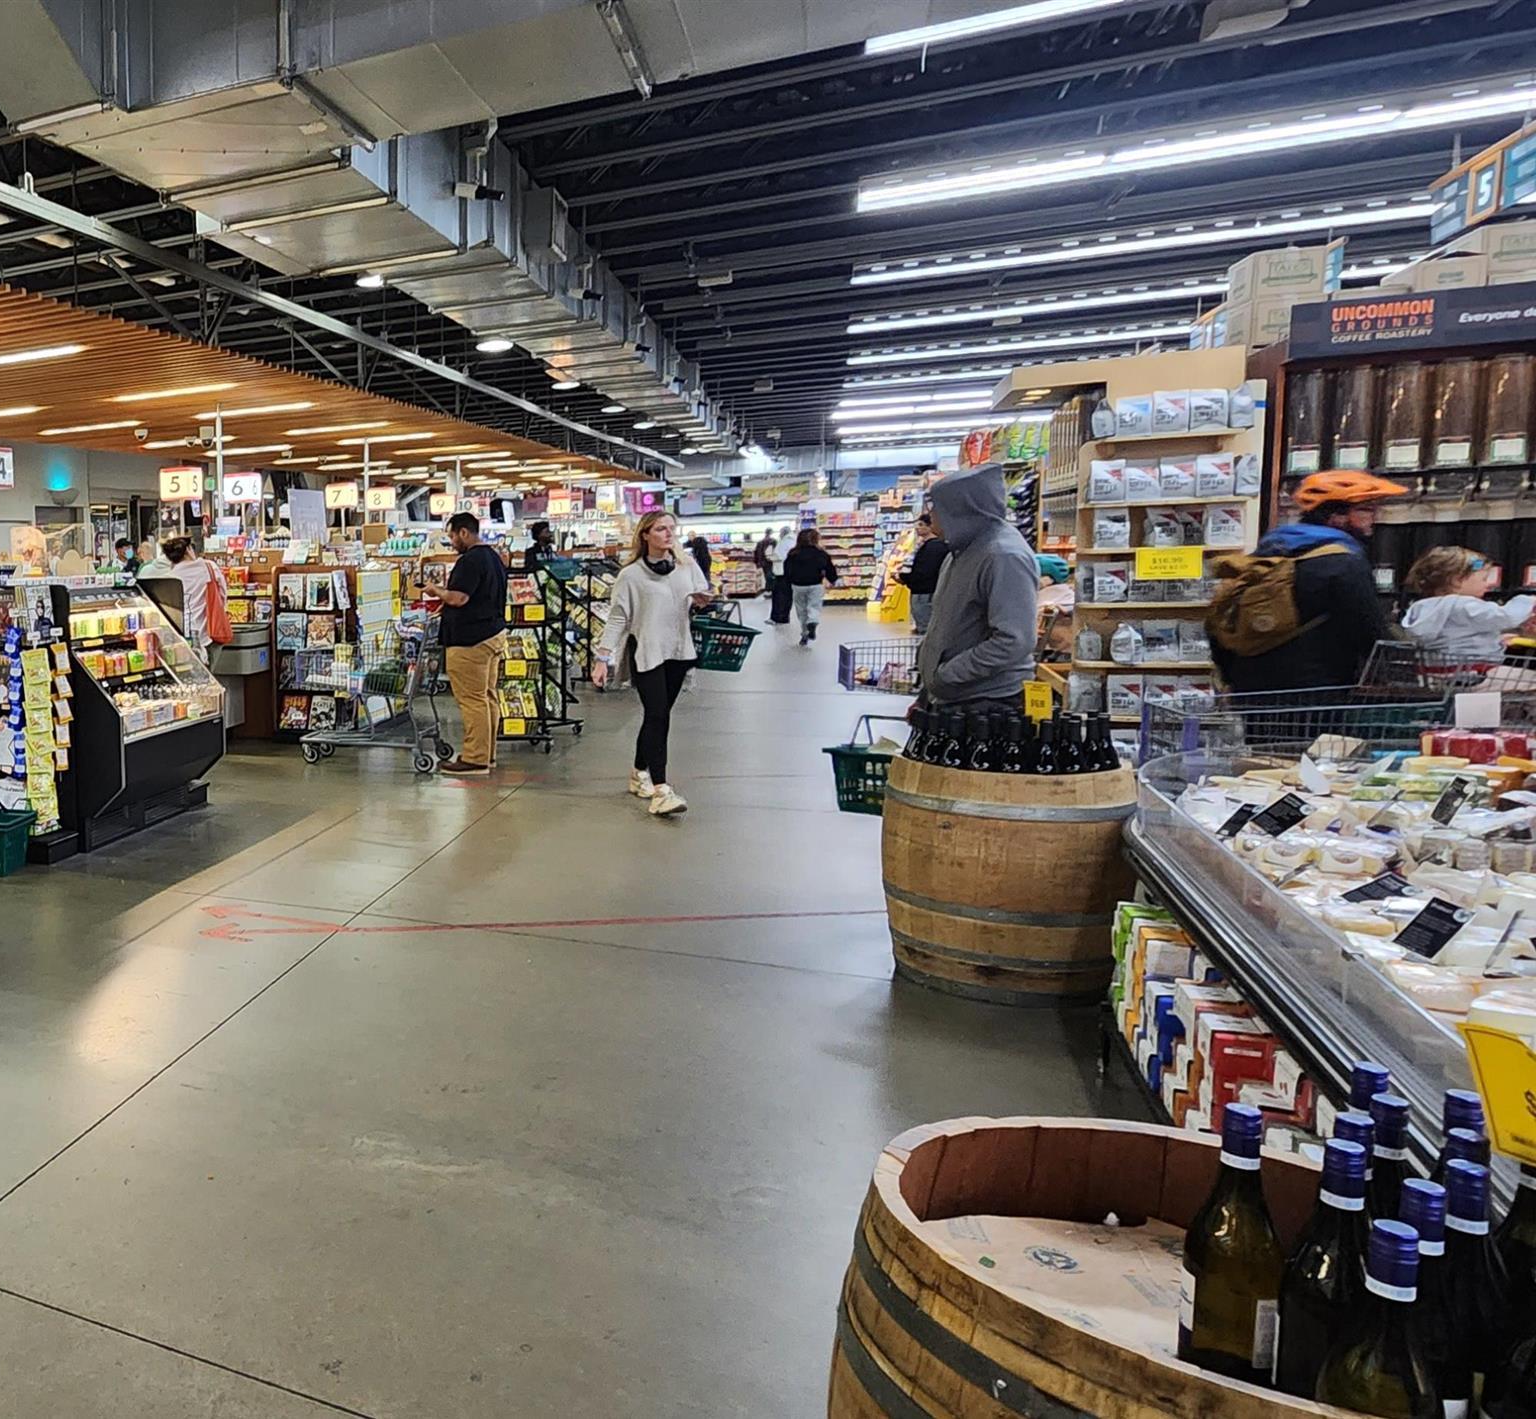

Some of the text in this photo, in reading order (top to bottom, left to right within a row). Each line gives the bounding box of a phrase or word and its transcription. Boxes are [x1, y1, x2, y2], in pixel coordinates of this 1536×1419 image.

[1478, 170, 1494, 206] 5
[1331, 299, 1435, 322] UNCOMMON
[1459, 309, 1521, 324] Everyone
[1331, 315, 1435, 333] GROUNDS
[1331, 328, 1433, 344] COFFEE ROASTERY
[169, 476, 181, 493] 5
[192, 475, 199, 493] 5
[231, 480, 243, 496] 6
[332, 490, 341, 504] 7
[373, 493, 382, 506] 8
[436, 498, 445, 510] 9
[458, 500, 473, 511] 10
